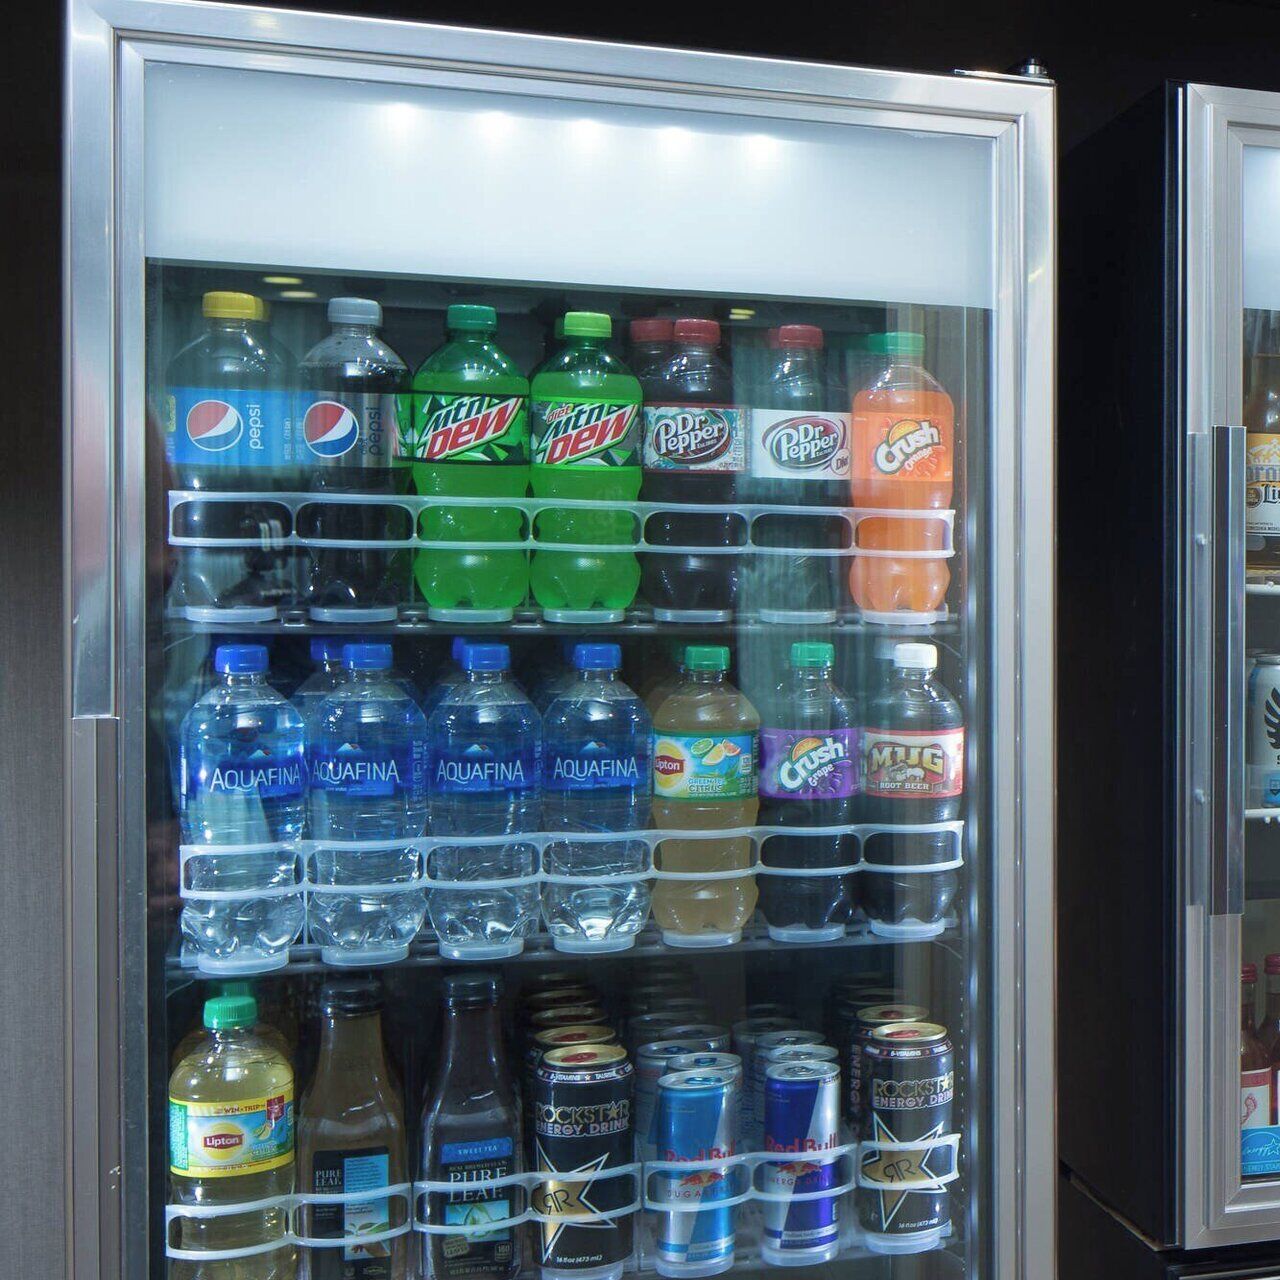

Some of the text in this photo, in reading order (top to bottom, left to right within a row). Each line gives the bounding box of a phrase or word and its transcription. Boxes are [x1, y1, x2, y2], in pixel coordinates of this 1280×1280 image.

[547, 405, 571, 422] diet
[677, 413, 705, 435] Dr
[246, 404, 264, 450] pepsi
[366, 406, 385, 456] pepsi
[659, 418, 723, 455] Pepper
[797, 423, 824, 441] Dr
[780, 427, 837, 462] Pepper
[876, 420, 940, 474] Crush
[312, 758, 401, 784] AQUAFINA
[436, 758, 525, 784] AQUAFINA
[553, 756, 638, 781] AQUAFINA
[780, 736, 846, 791] Crush
[872, 745, 945, 774] MUG
[209, 765, 301, 792] AQUAFINA
[808, 764, 835, 787] Grape
[879, 782, 930, 791] ROOT BEER
[688, 784, 722, 793] CITRUS
[536, 1120, 629, 1135] ENERGY DRINK
[206, 1136, 239, 1147] Lipton
[315, 1170, 342, 1179] PURE
[450, 1166, 508, 1184] PURE
